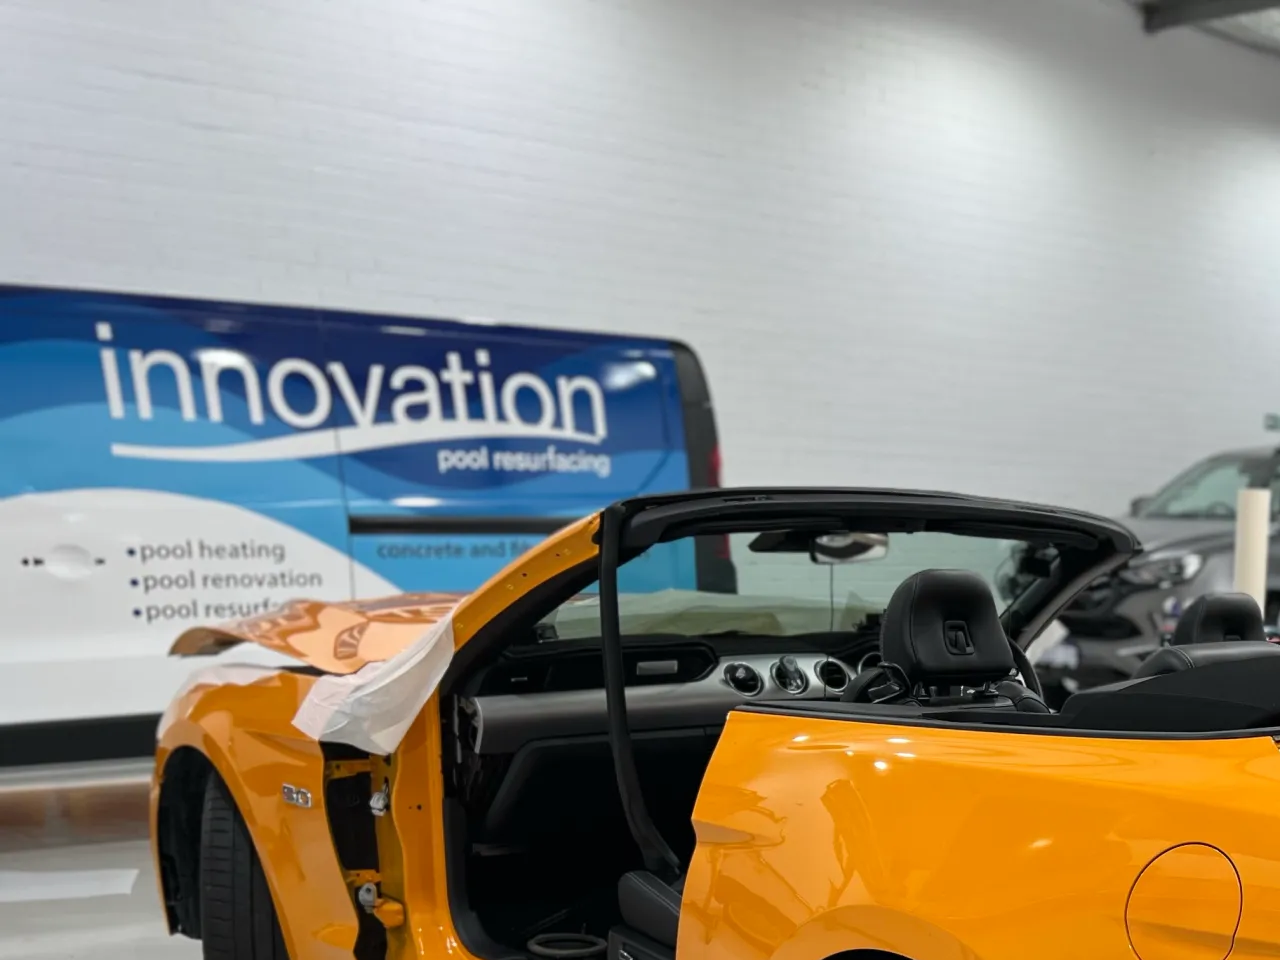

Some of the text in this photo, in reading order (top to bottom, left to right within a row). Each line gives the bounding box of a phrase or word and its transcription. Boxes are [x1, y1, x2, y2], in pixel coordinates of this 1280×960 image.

[95, 321, 607, 440] innovation
[437, 444, 611, 478] pool resurfacing
[140, 539, 286, 563] pool heating
[376, 542, 464, 560] concrete
[469, 541, 507, 559] and
[143, 569, 323, 594] pool renovation
[146, 599, 199, 624] pool
